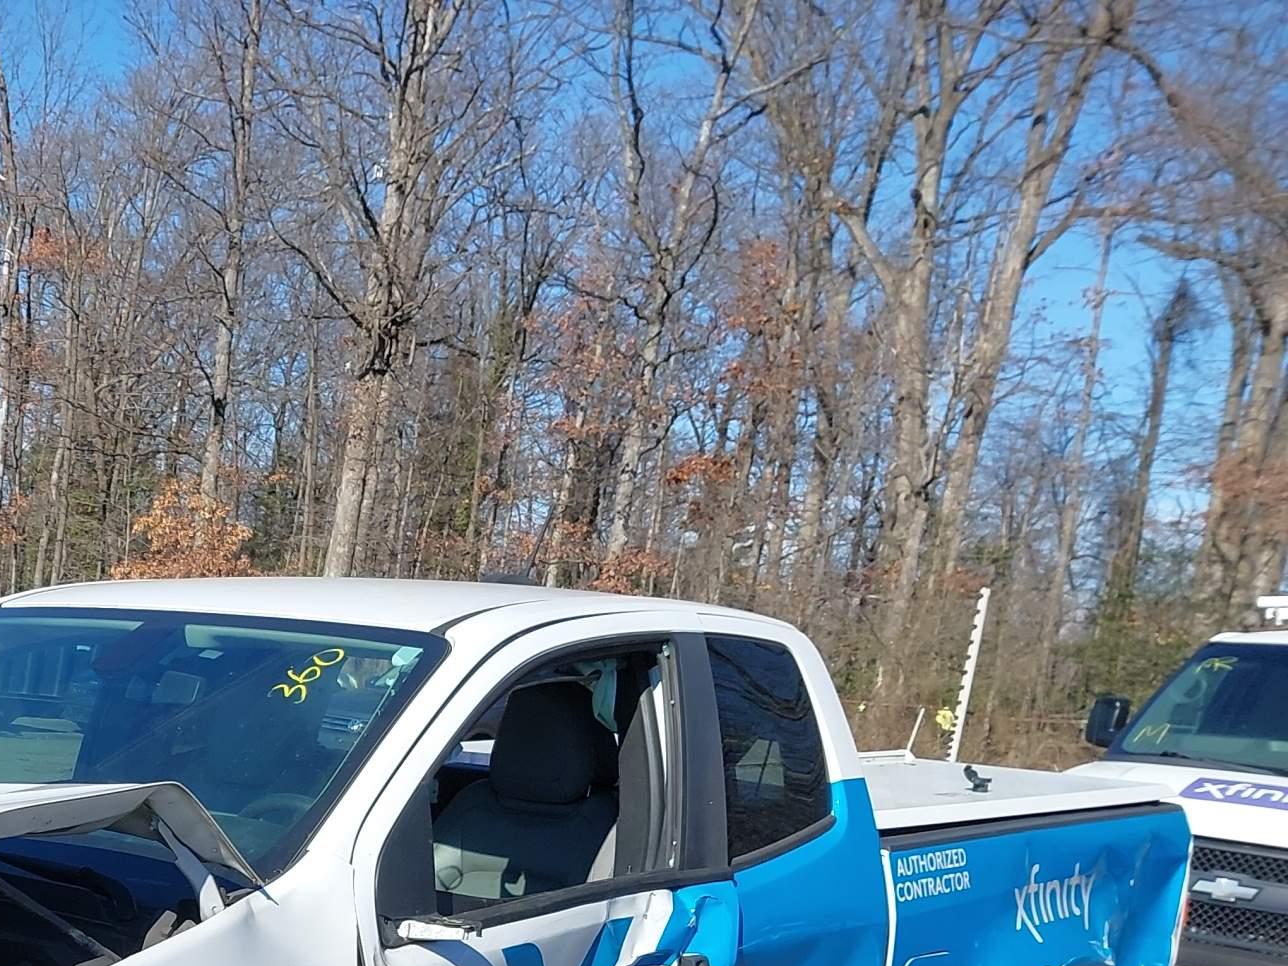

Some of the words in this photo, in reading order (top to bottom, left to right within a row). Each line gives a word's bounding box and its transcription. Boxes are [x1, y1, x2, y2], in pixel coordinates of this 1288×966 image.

[267, 647, 346, 705] 360
[896, 848, 967, 877] AUTHORIZED
[896, 871, 971, 903] CONTRACTOR
[1014, 862, 1096, 944] xfinity
